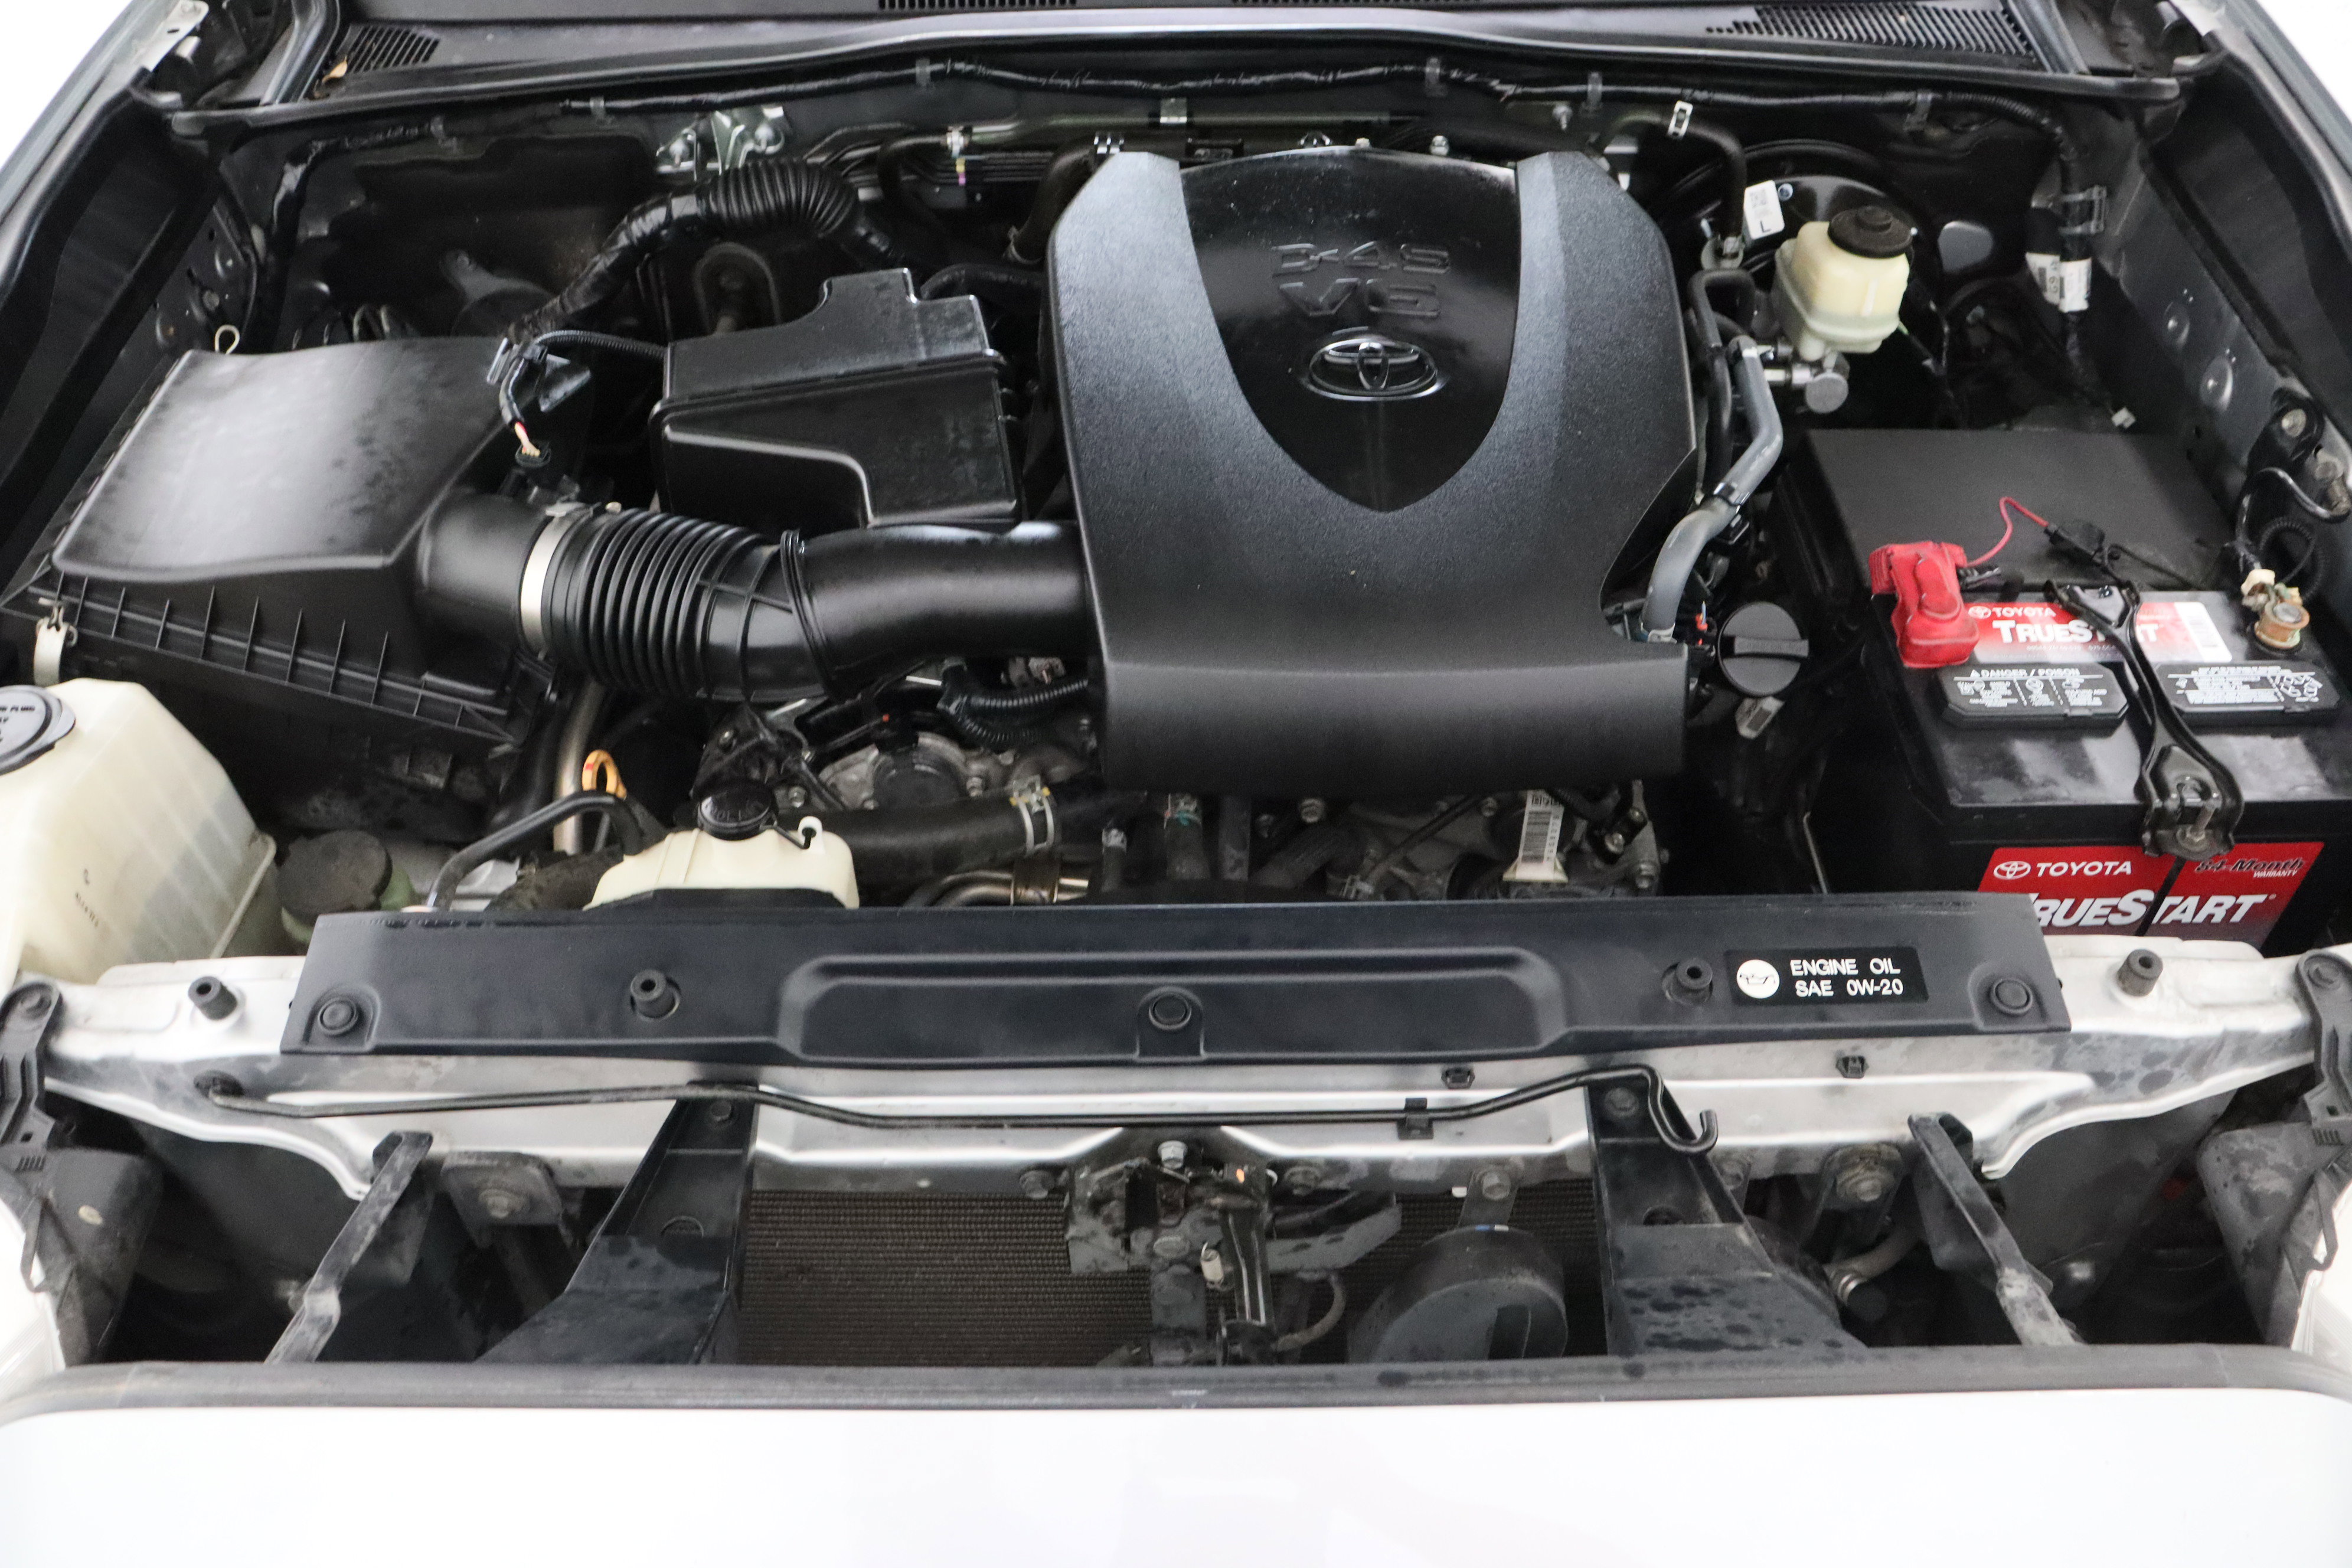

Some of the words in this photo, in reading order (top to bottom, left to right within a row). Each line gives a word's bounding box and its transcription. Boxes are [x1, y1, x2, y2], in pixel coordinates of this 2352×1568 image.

[1991, 606, 2057, 618] TOYOTA
[2037, 668, 2080, 677] POISON
[2036, 861, 2132, 877] TOYOTA
[2194, 857, 2305, 873] 84-Month
[2253, 870, 2298, 878] WARRANTY
[2030, 889, 2268, 927] RUESTART
[1789, 958, 1859, 976] ENGINE
[1869, 957, 1902, 975] OIL
[1795, 979, 1834, 998] SAE
[1846, 978, 1904, 997] 0W-20
